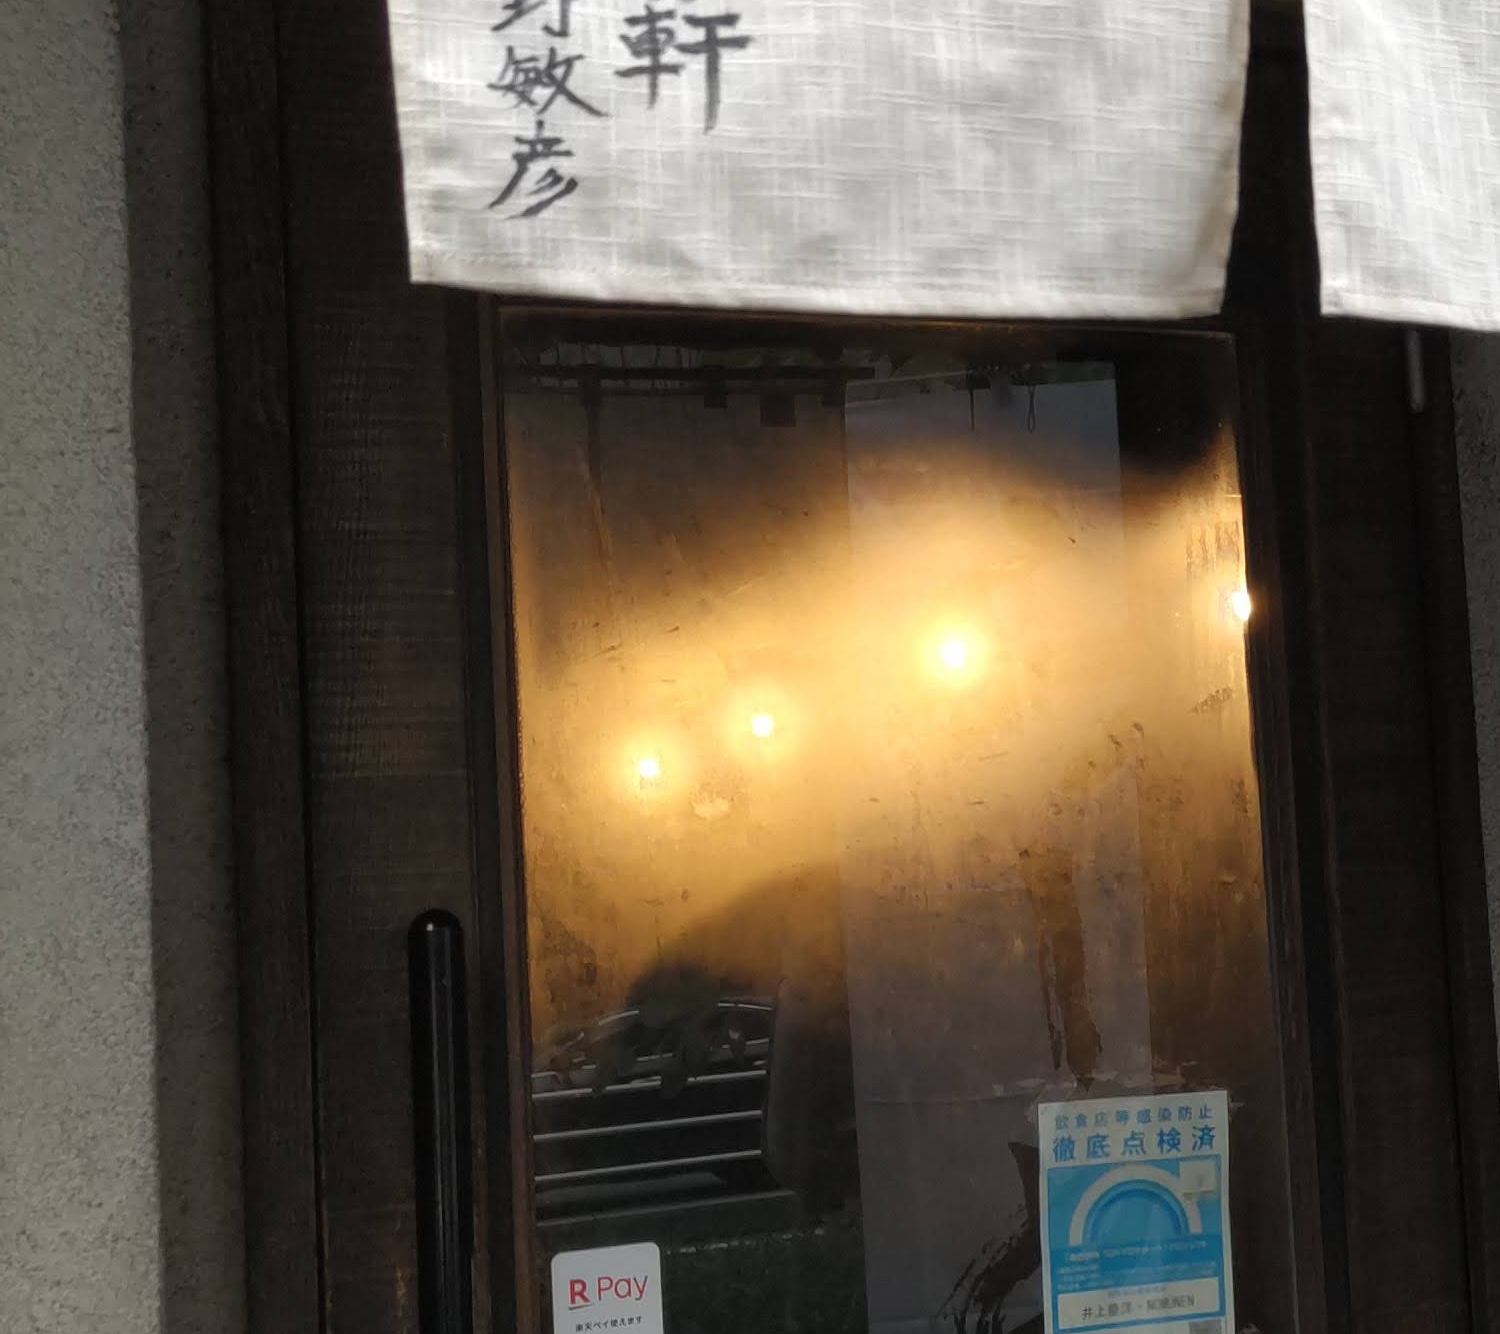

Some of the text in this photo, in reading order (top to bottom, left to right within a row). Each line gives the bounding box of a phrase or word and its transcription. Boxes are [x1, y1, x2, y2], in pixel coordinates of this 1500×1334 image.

[1052, 1124, 1216, 1163] 徹底点検済
[596, 1274, 649, 1302] Pay
